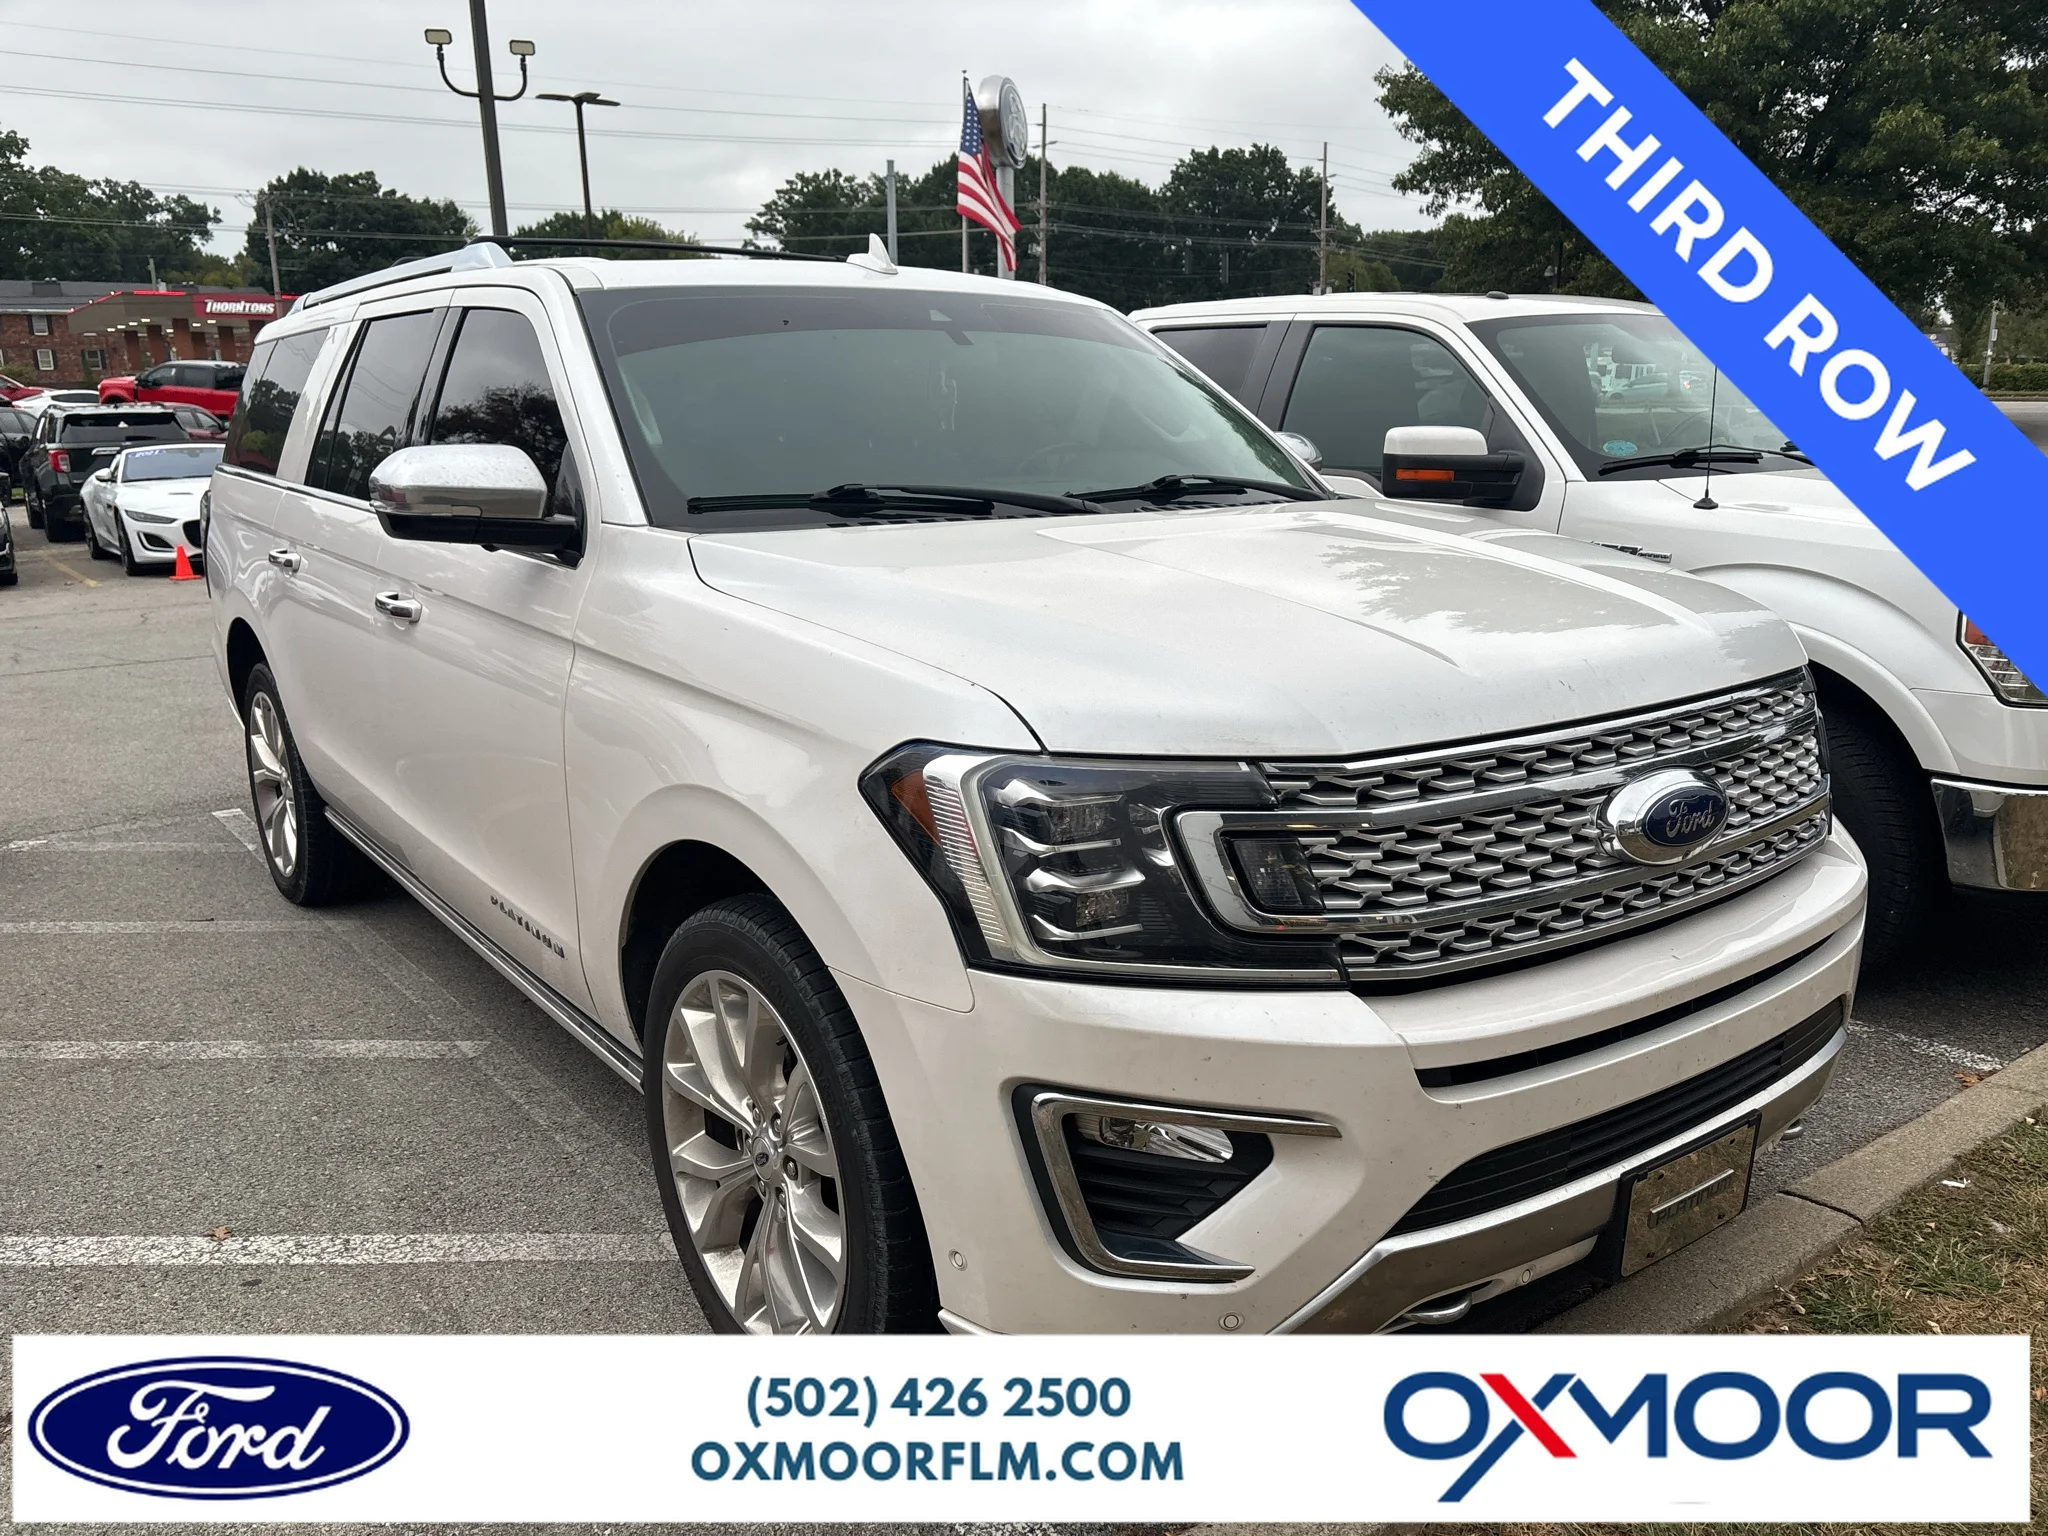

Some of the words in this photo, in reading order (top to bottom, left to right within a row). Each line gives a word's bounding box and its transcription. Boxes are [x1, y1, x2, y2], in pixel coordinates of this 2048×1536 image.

[204, 299, 275, 315] THORNTONS
[1665, 794, 1716, 838] Ford
[490, 894, 565, 959] PLATINUM
